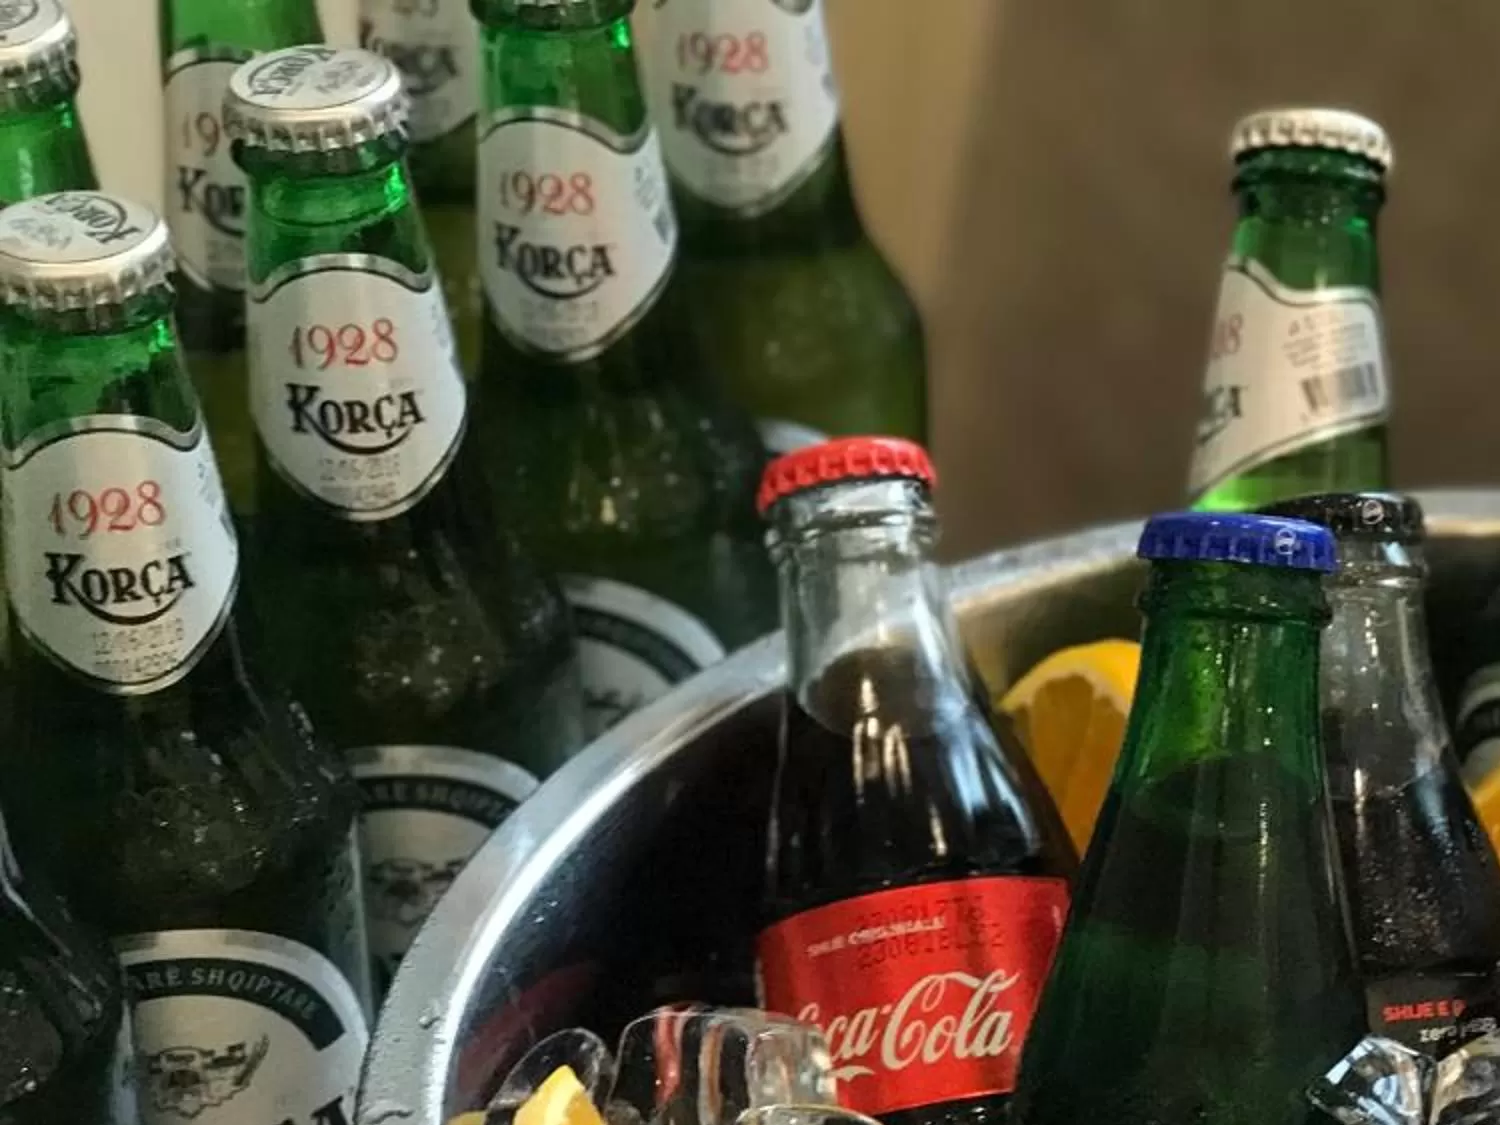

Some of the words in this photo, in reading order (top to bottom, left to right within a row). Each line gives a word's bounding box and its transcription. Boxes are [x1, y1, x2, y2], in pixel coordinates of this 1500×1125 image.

[676, 31, 769, 75] 1928
[181, 111, 221, 158] 19
[501, 171, 597, 217] 1928
[288, 317, 399, 370] 1928
[285, 383, 426, 447] KORÇA
[48, 480, 166, 536] 1928
[45, 552, 196, 616] KORÇA
